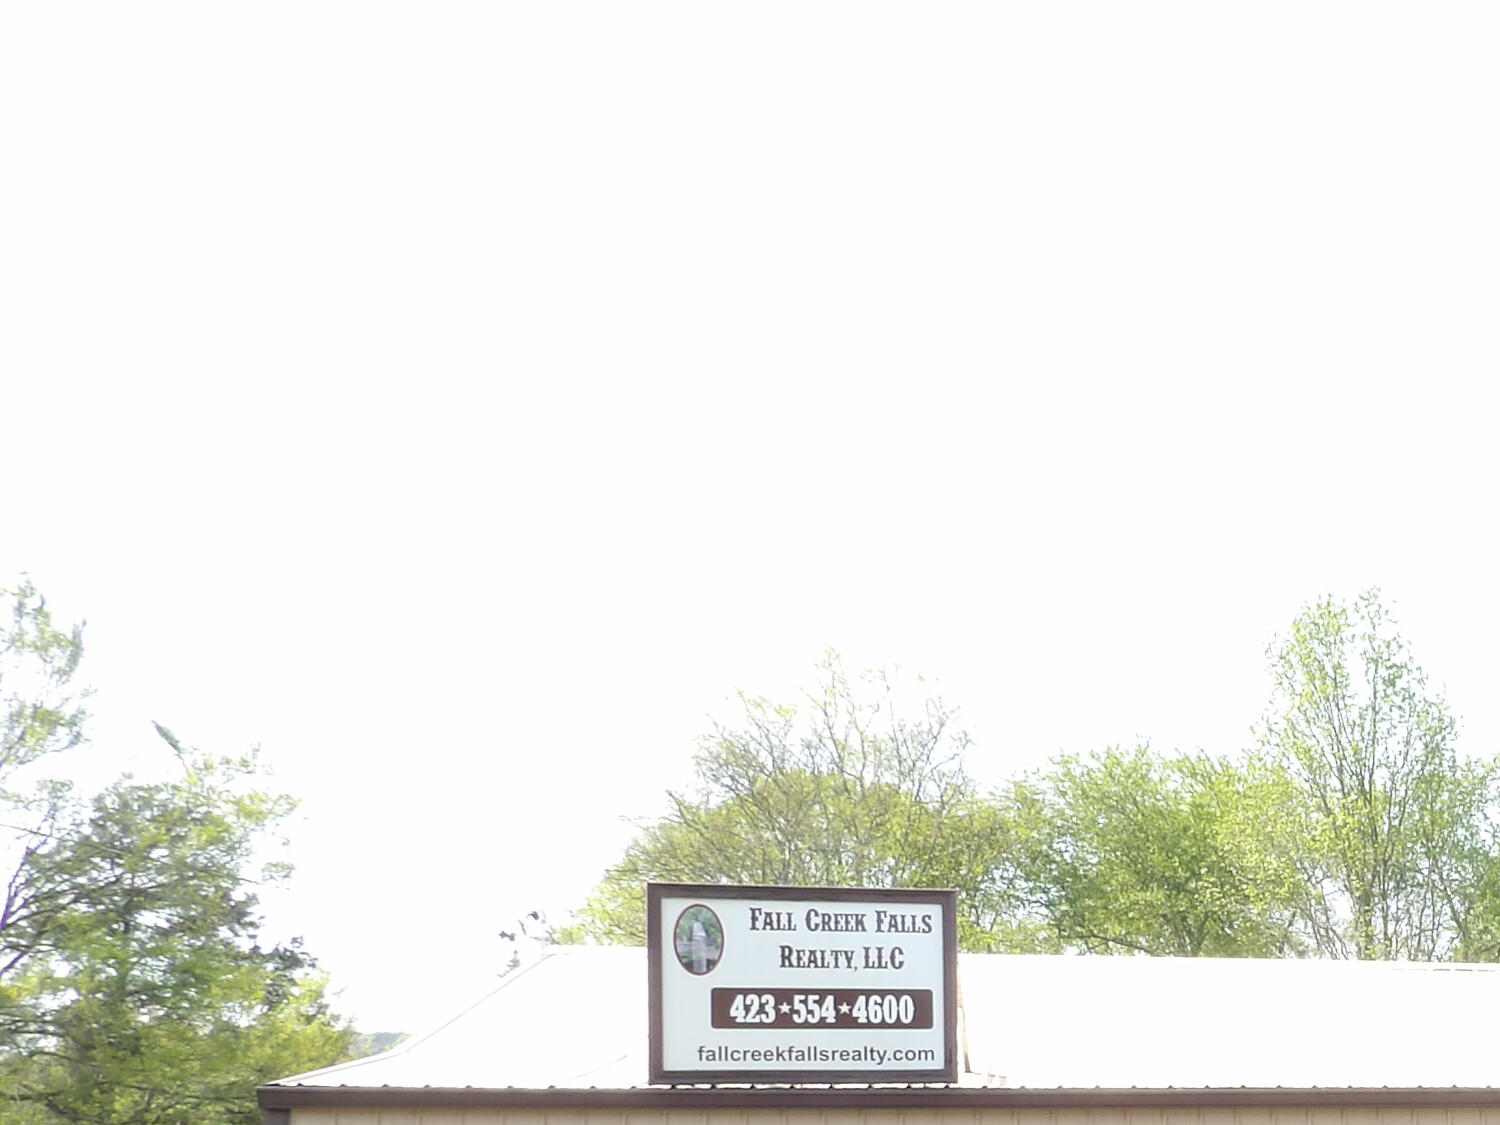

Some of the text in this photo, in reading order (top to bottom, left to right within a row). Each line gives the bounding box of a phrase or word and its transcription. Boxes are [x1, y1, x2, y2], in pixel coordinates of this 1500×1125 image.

[749, 907, 933, 935] FALL CREEK FALLS
[779, 945, 905, 972] REALTY, LLC
[697, 1045, 935, 1065] fallcreekfallsrealty.com
